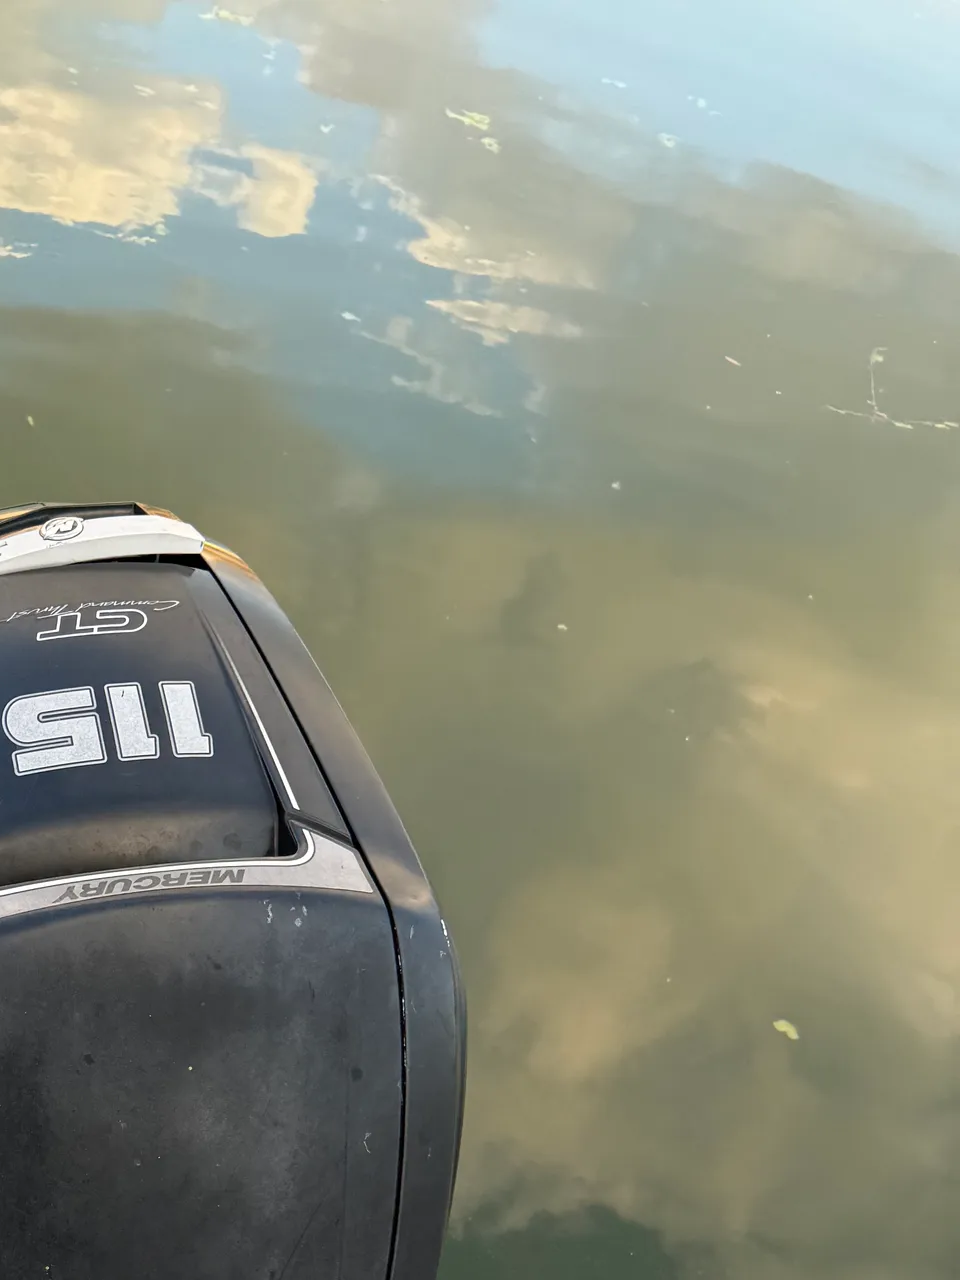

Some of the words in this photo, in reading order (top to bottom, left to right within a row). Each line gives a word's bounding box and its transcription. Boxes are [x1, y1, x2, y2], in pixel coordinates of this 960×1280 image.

[76, 599, 180, 612] Command
[1, 680, 214, 777] 115
[54, 868, 246, 904] MERCURY
